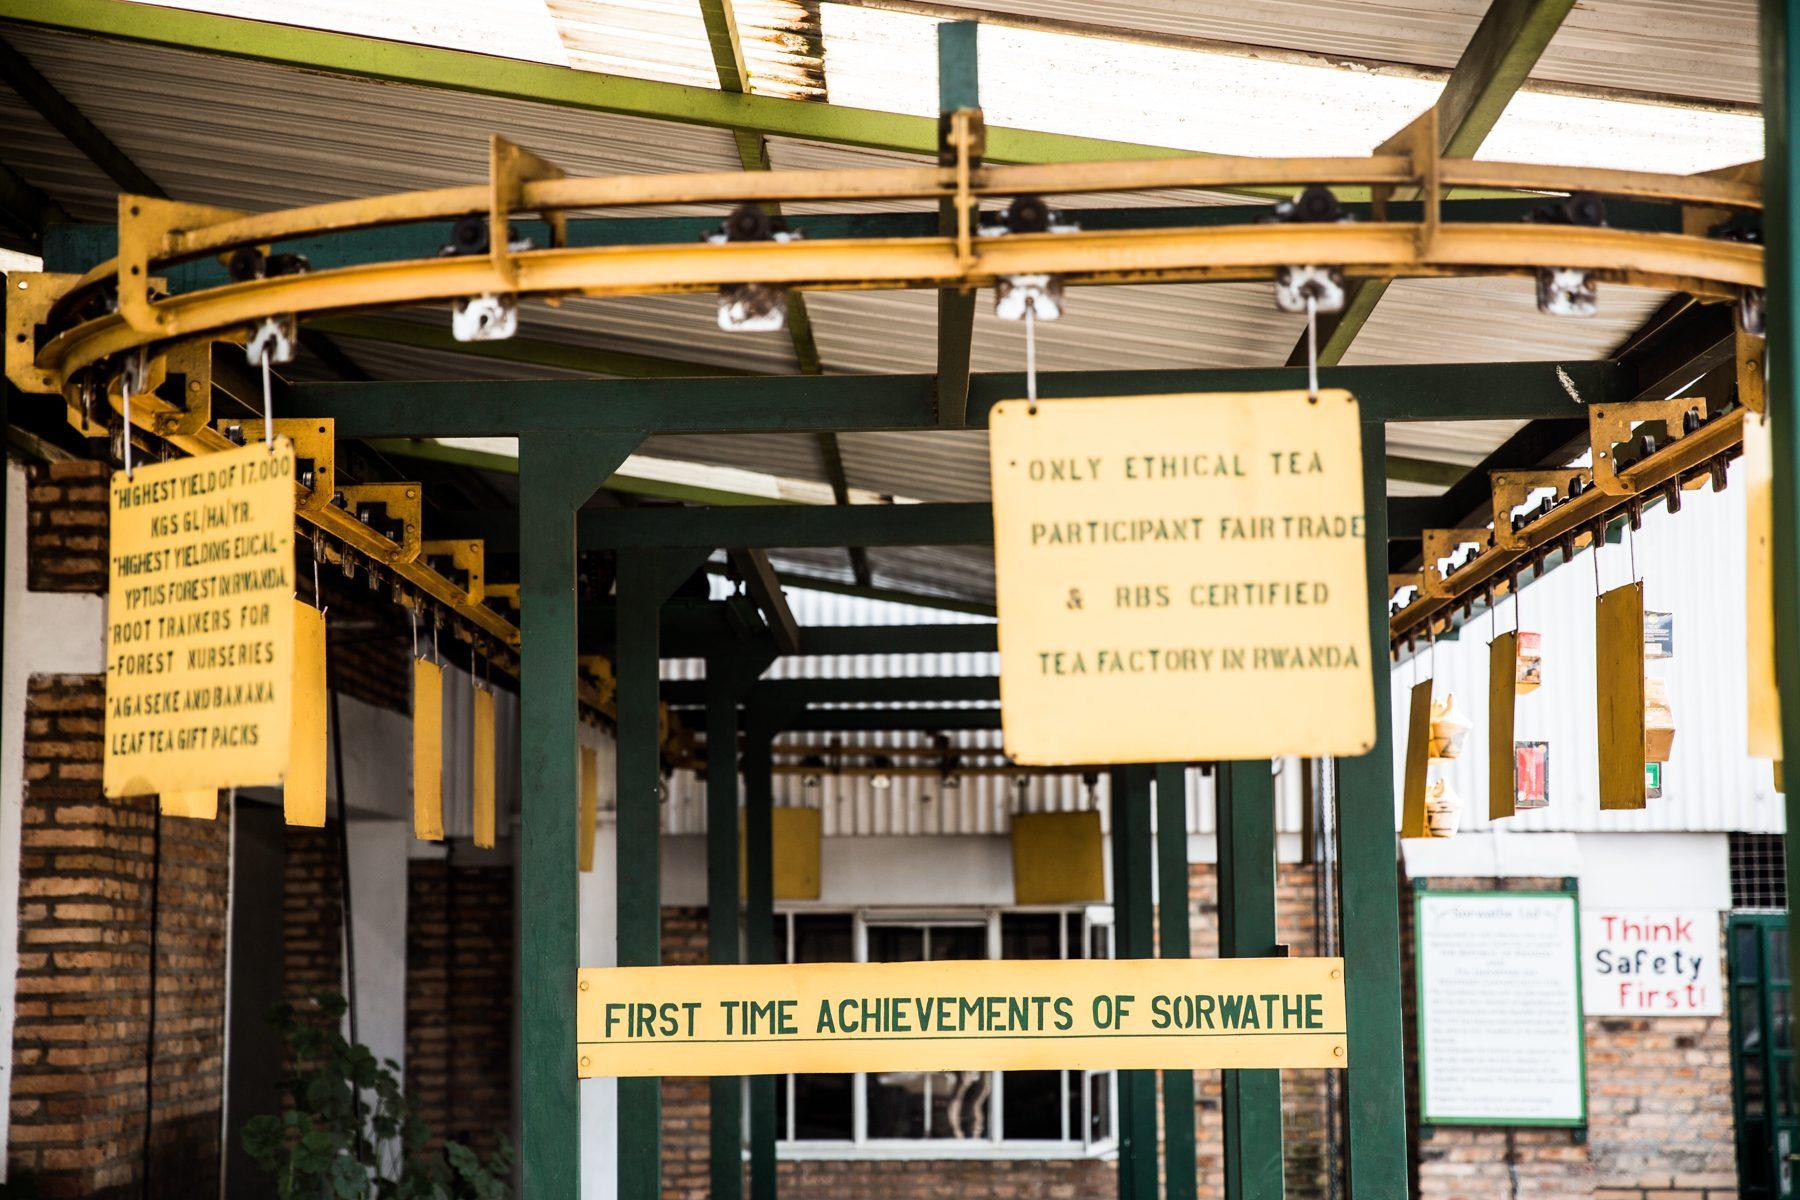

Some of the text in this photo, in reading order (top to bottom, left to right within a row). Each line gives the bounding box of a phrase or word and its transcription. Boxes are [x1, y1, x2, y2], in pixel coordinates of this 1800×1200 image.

[1029, 451, 1324, 482] ONLY ETHICAL TEA
[118, 478, 176, 510] HIGHEST
[180, 471, 215, 498] YIELD
[218, 465, 235, 490] OF
[151, 514, 178, 538] KGS
[1031, 518, 1203, 546] PARTICIPANT
[118, 549, 170, 577] HIGHEST
[175, 540, 230, 569] YIELDING
[125, 583, 165, 610] YPTUS
[169, 576, 217, 603] FOREST
[219, 573, 230, 596] IN
[1066, 582, 1329, 610] & RBS CERTIFIED
[113, 604, 270, 645] ROOT TRAINERS FOR
[188, 642, 274, 670] NURSERIES
[1038, 646, 1360, 676] TEA FACTORY IN RWANDA
[183, 689, 210, 712] AND
[213, 681, 274, 709] BANANA
[112, 724, 259, 756] LEAF TEA GIFT PACKS
[1600, 915, 1693, 944] Think
[1596, 949, 1702, 982] Safety
[605, 992, 1325, 1039] FIRST TIME ACHIEVEMENTS OF SORWATHE
